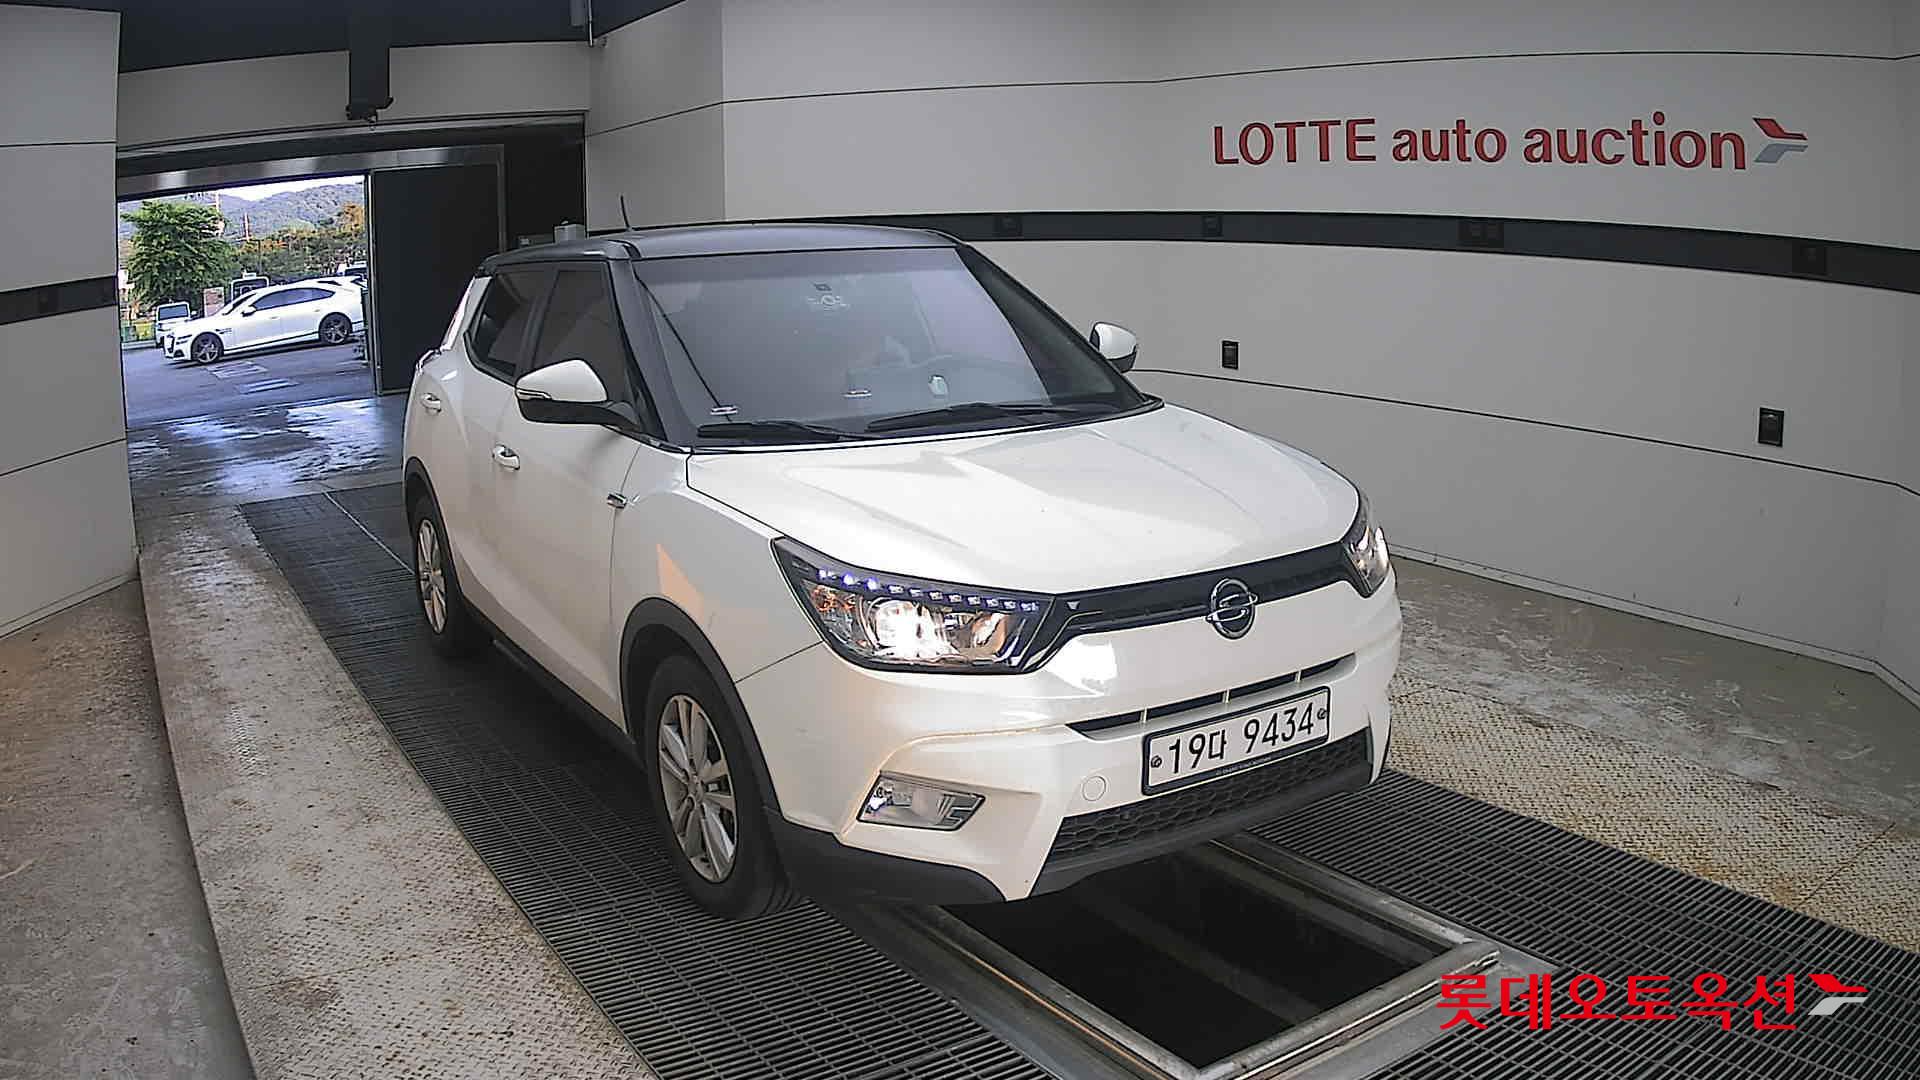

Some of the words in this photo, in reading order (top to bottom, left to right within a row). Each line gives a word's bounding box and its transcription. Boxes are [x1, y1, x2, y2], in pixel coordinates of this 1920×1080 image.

[1213, 118, 1376, 166] LOTTE
[1392, 119, 1507, 164] auto
[1523, 111, 1747, 171] auction
[1168, 729, 1228, 774] 19다
[1243, 702, 1314, 754] 9434
